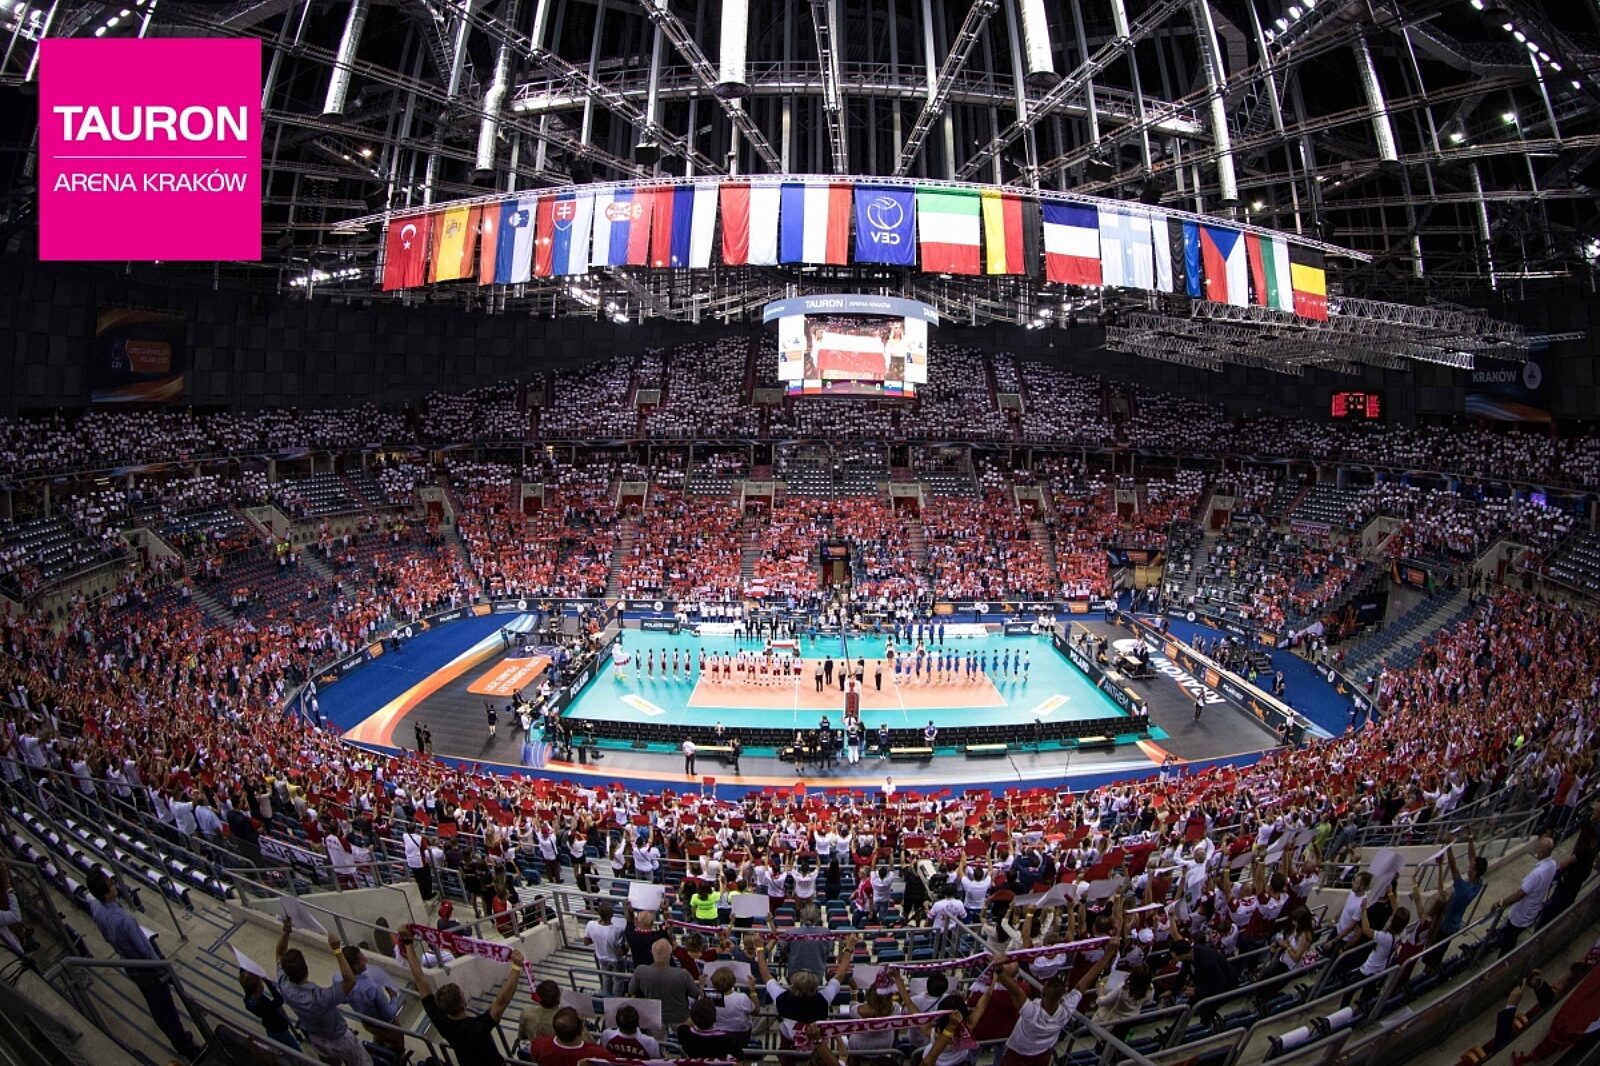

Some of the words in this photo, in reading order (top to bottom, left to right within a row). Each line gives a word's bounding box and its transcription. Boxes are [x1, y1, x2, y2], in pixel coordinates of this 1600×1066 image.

[805, 299, 843, 309] TAURON
[1472, 369, 1517, 384] KRAKÓW
[1070, 649, 1089, 674] POLAND
[1103, 680, 1129, 710] ANTHEM
